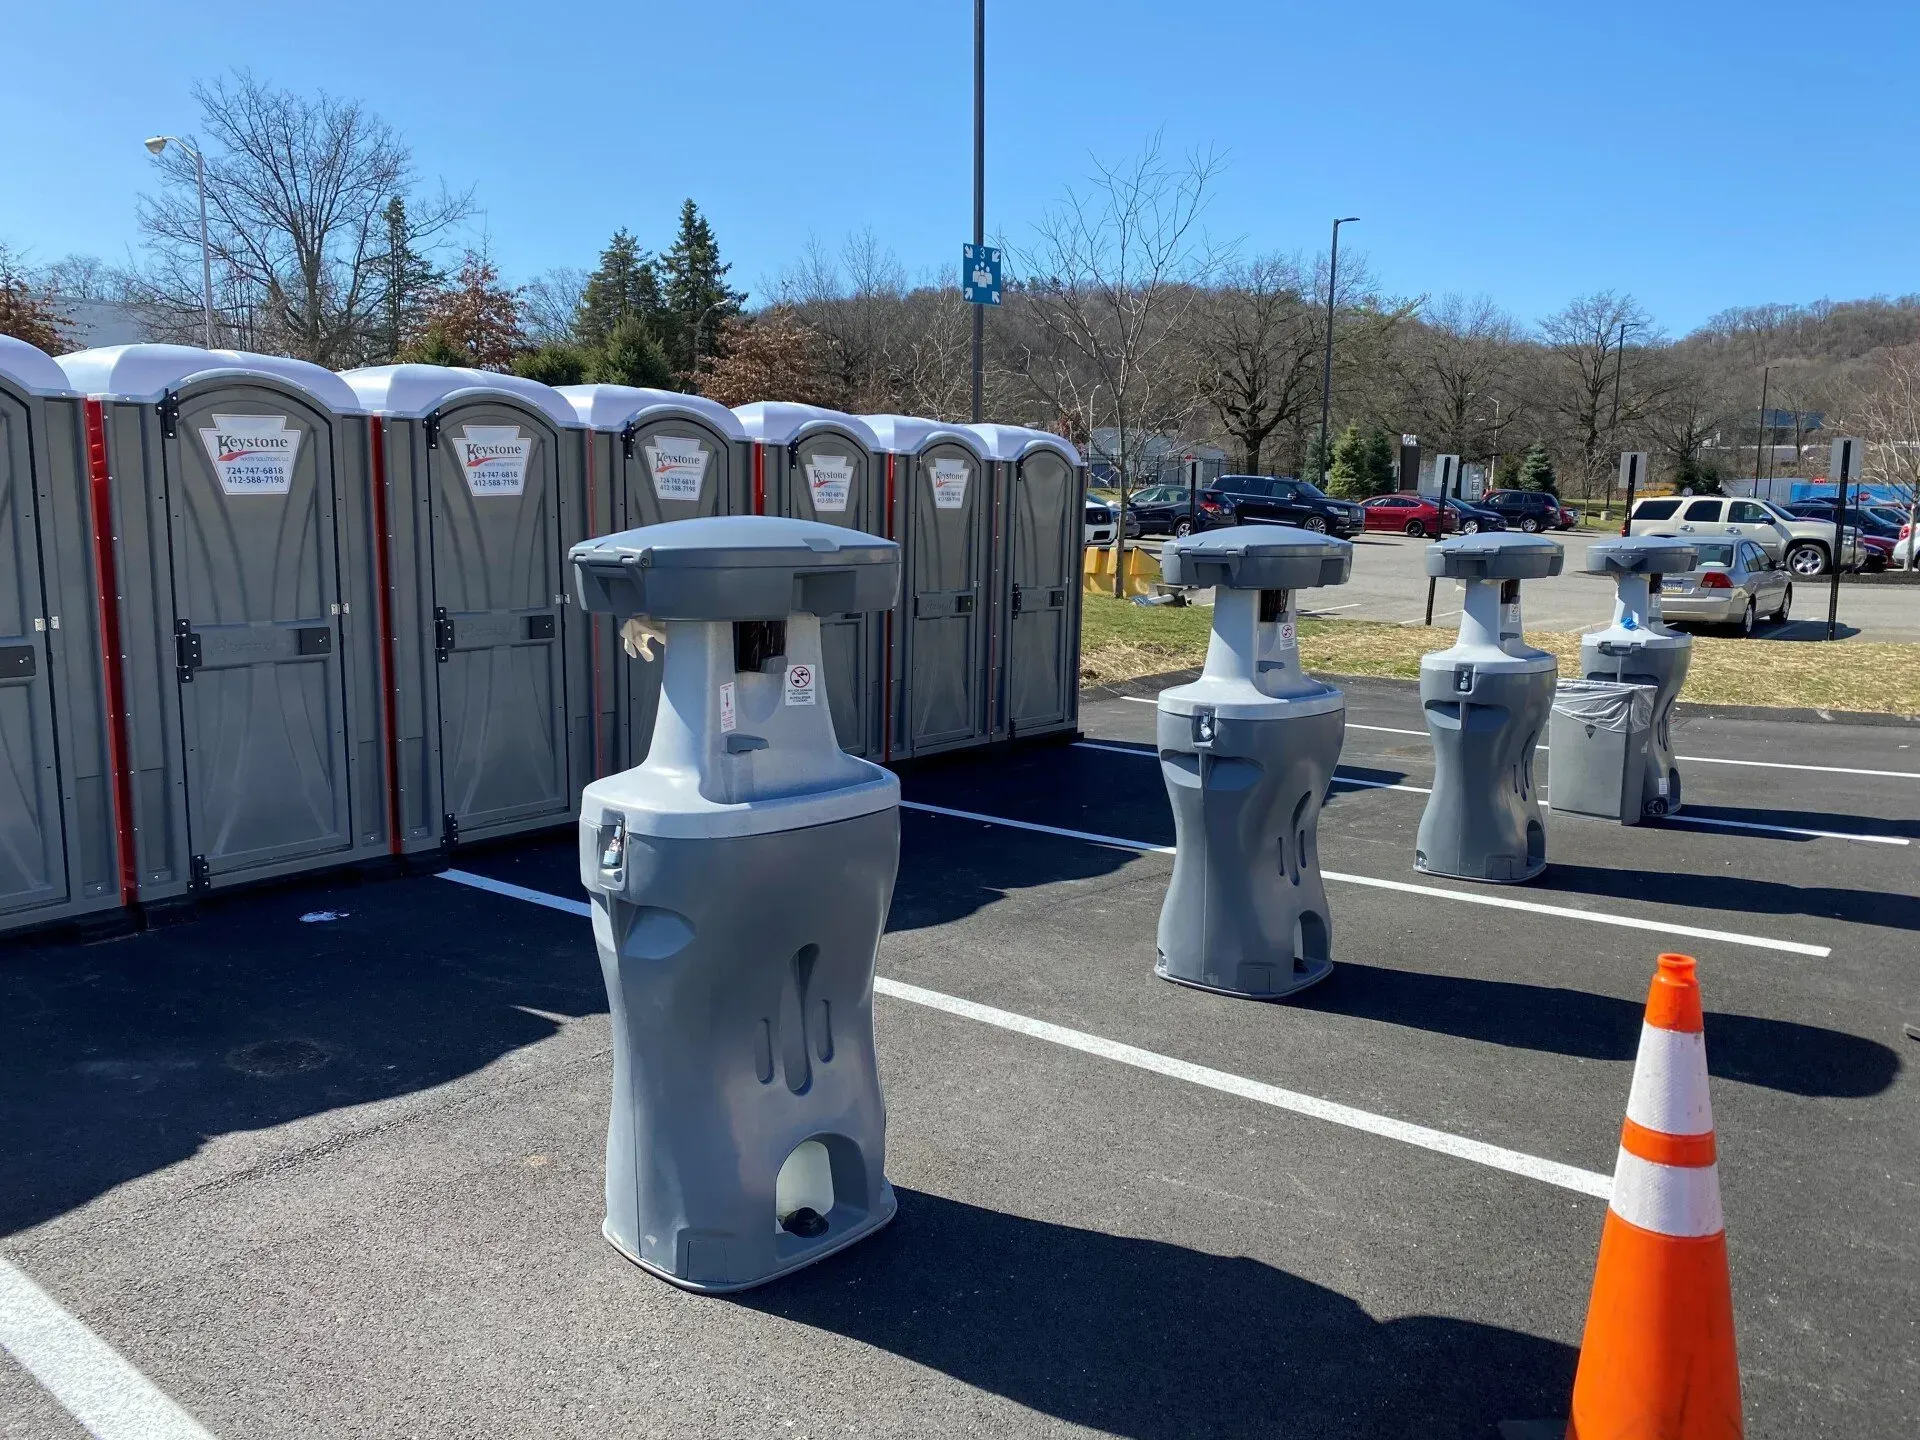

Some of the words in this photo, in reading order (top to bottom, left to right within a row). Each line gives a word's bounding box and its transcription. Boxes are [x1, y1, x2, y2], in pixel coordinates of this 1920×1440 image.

[980, 247, 986, 259] 3
[216, 435, 288, 457] Keystone
[465, 444, 521, 463] Keystone
[656, 452, 700, 468] Keystone
[226, 467, 284, 475] 724-747-6818
[813, 469, 847, 483] Keystone
[936, 471, 964, 484] Keystone
[227, 475, 285, 484] 412-588-7198
